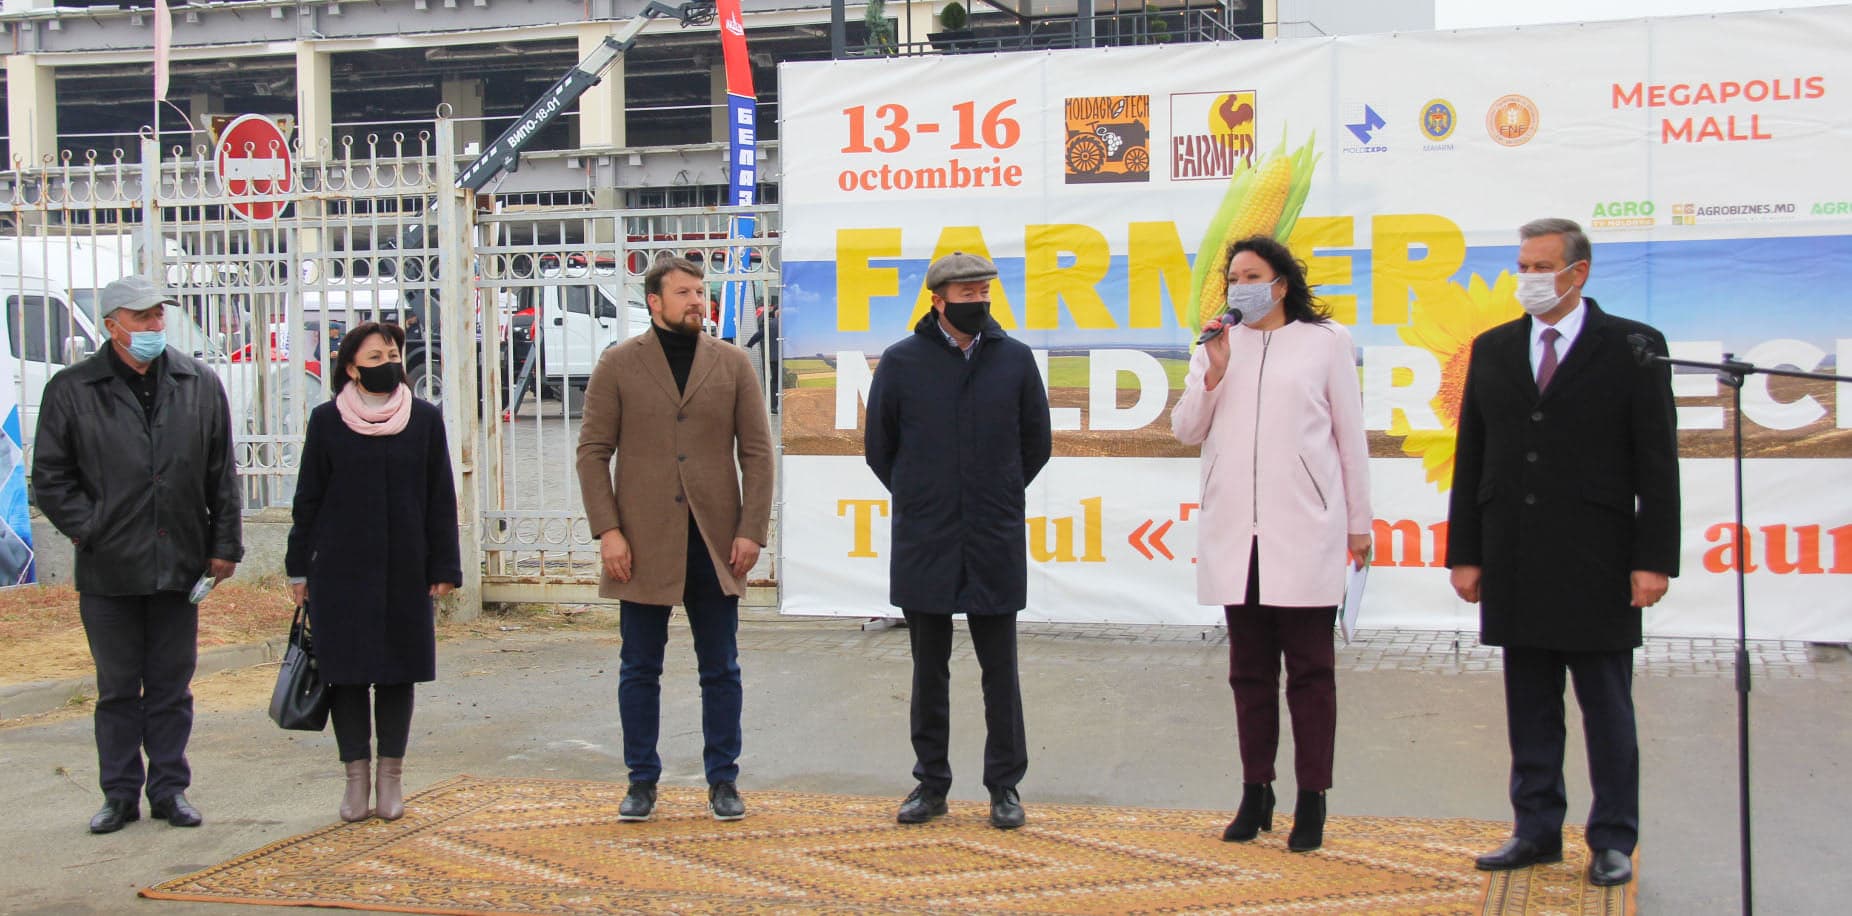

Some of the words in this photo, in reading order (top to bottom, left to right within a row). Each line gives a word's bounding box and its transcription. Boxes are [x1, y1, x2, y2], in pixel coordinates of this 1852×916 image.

[1612, 76, 1825, 109] MEGAPOLIS
[507, 97, 561, 148] ВИПО-18-01
[1662, 114, 1772, 144] MALL
[1173, 134, 1254, 178] FARMER
[838, 156, 1022, 191] octombrie
[1593, 200, 1655, 217] AGRO
[1697, 203, 1796, 217] AGROBIZNES.MD
[1811, 201, 1852, 215] AGR
